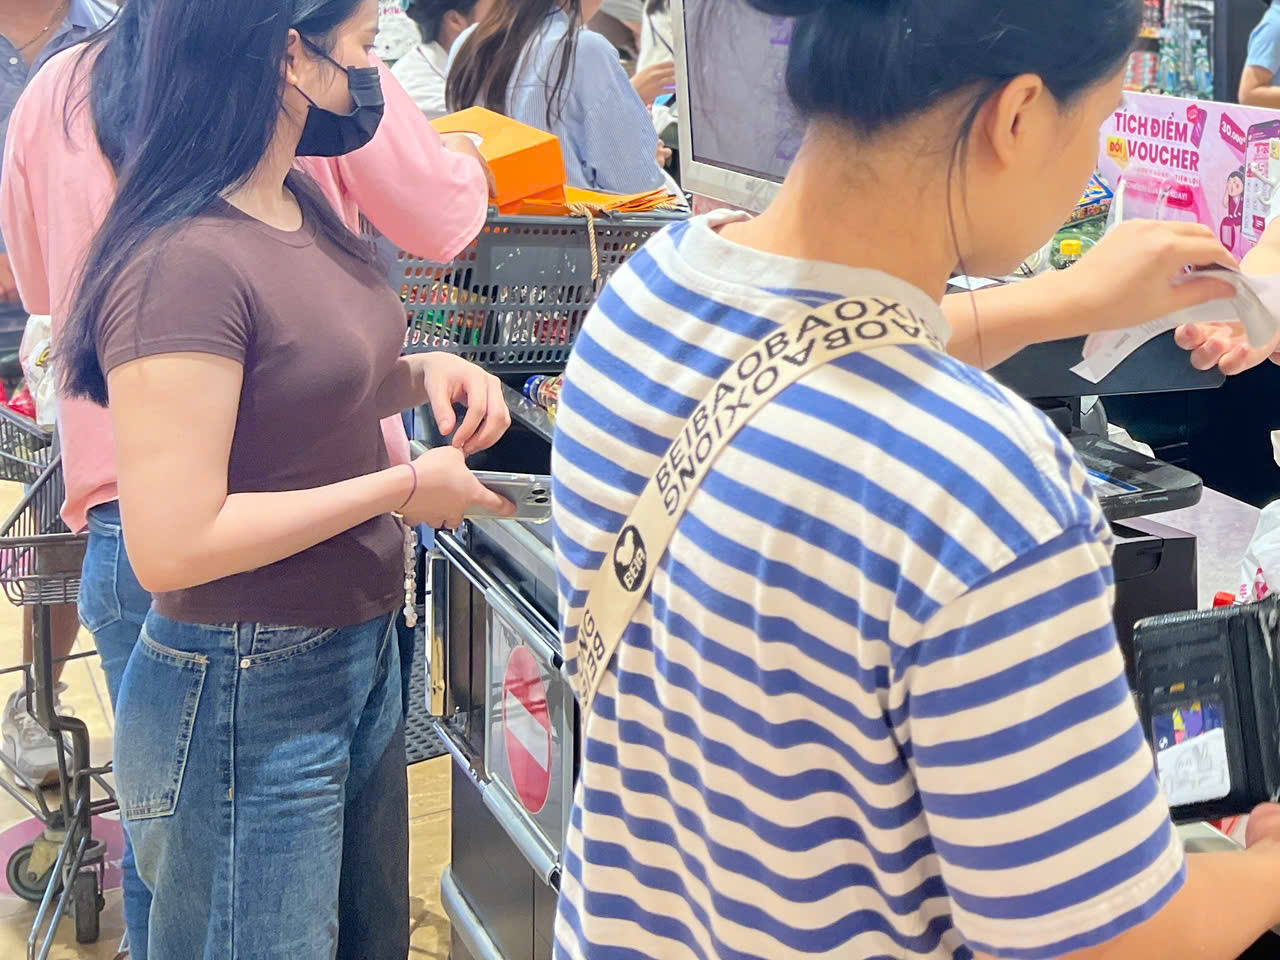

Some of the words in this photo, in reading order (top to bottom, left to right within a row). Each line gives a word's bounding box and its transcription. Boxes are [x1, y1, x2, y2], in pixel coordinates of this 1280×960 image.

[1114, 108, 1148, 137] TÍCH
[1151, 112, 1188, 143] ĐIỂM
[1127, 139, 1200, 172] VOUCHER
